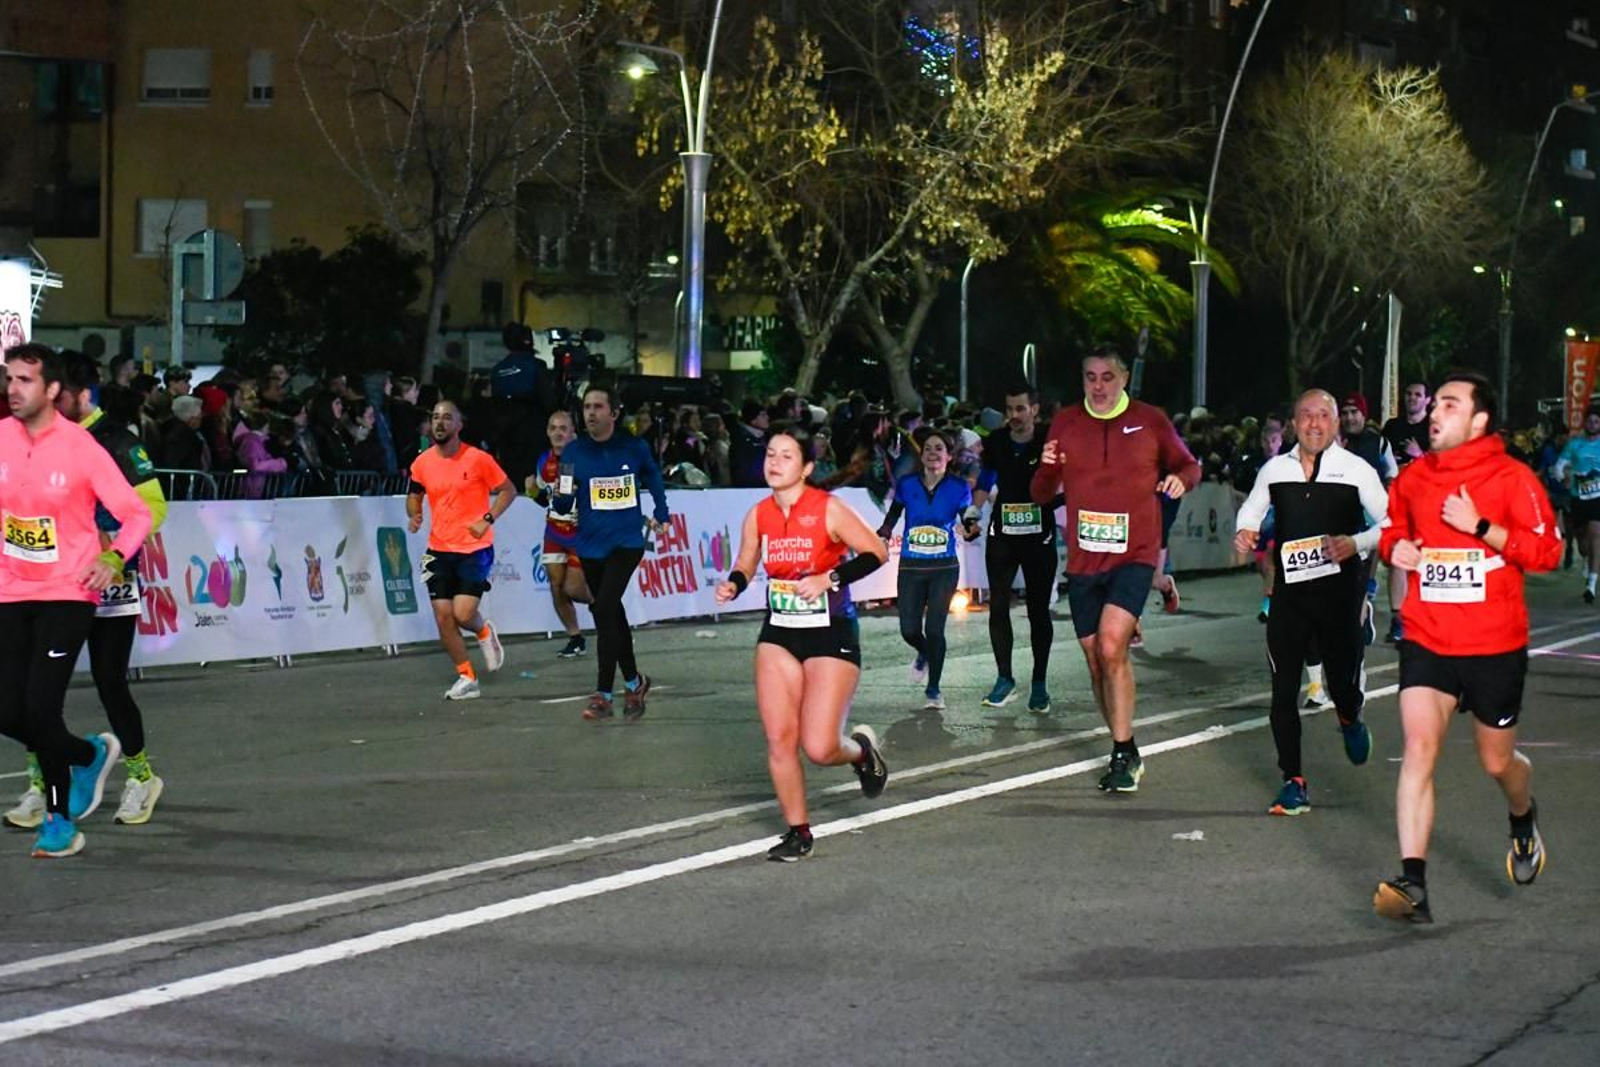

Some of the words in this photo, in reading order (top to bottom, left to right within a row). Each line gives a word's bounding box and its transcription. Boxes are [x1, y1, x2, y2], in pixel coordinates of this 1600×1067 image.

[598, 487, 630, 500] 6590
[1008, 512, 1034, 524] 889
[8, 524, 51, 546] 3564
[1080, 524, 1124, 540] 2735
[1287, 549, 1326, 567] 494
[1426, 564, 1475, 582] 8941
